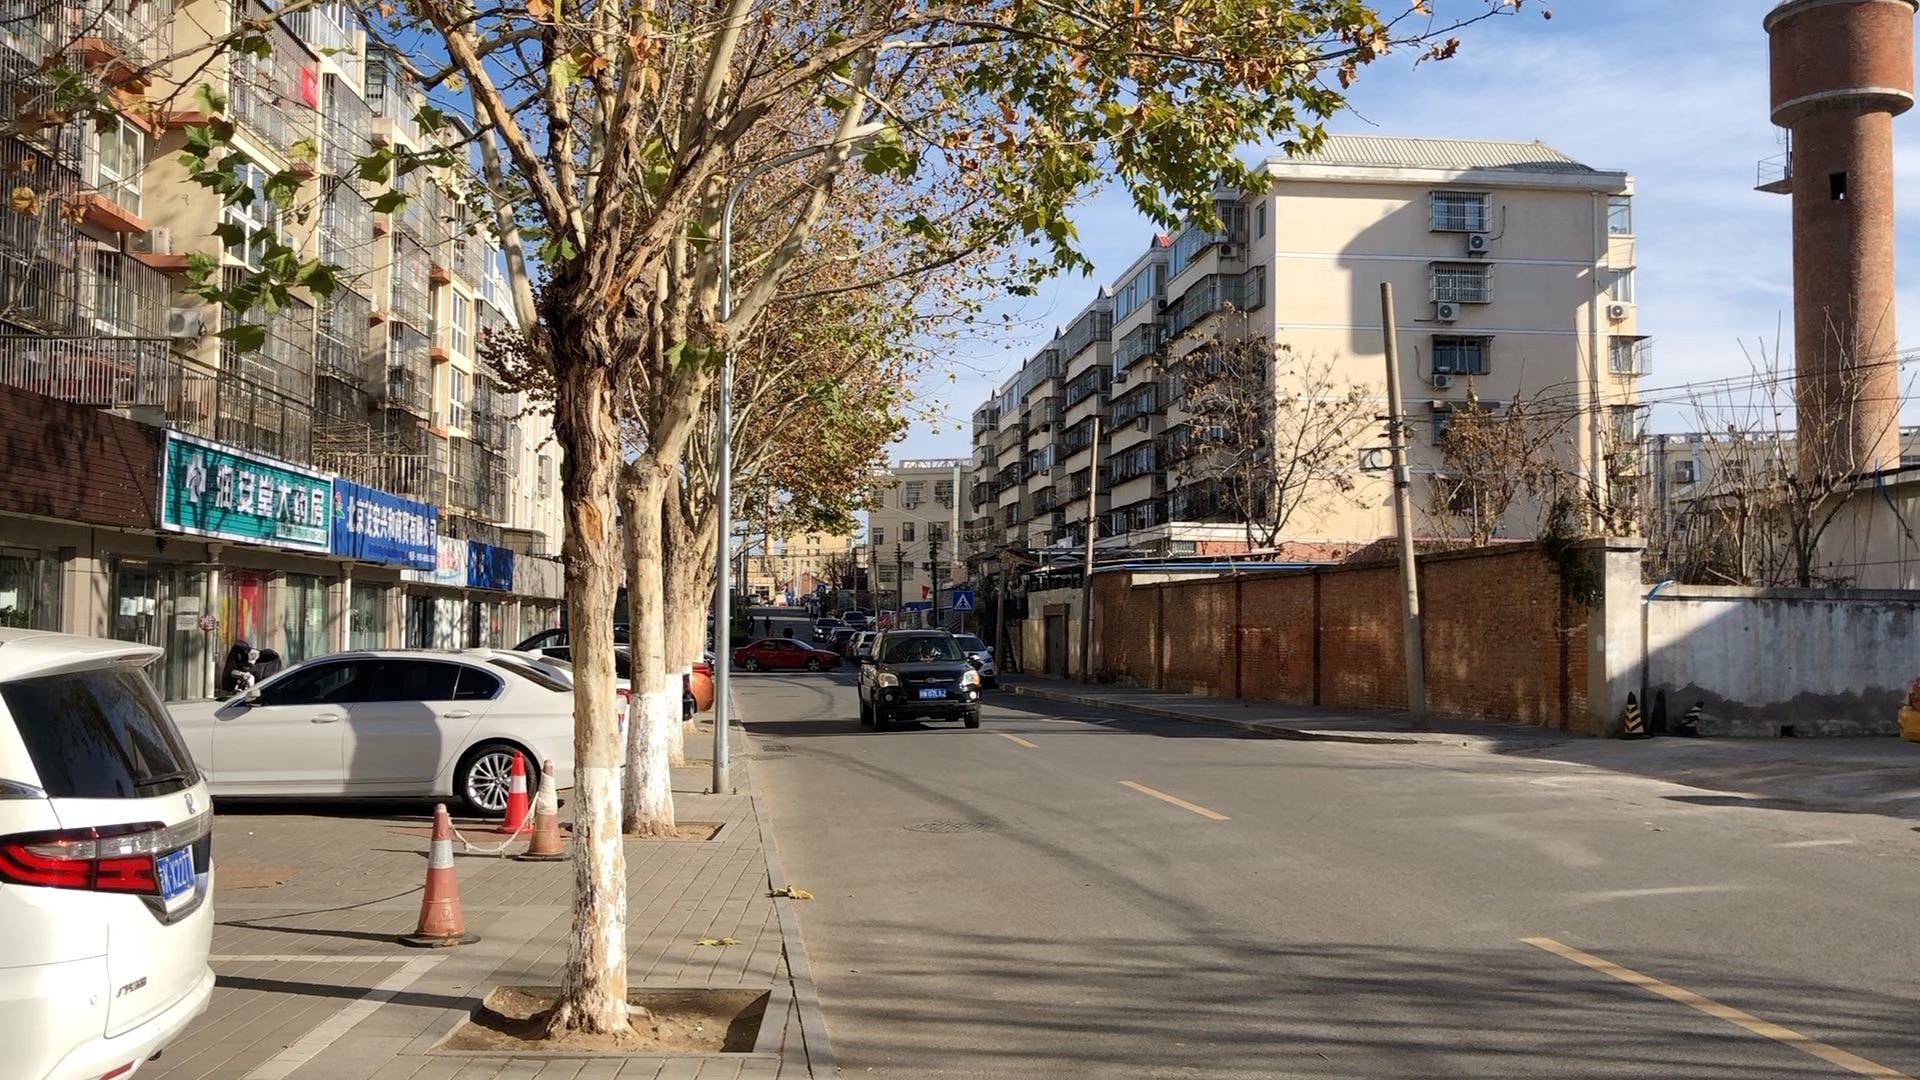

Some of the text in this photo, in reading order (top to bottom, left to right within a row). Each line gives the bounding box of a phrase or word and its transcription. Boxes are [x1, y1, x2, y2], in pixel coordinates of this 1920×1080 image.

[214, 463, 325, 527] 润安堂大药房
